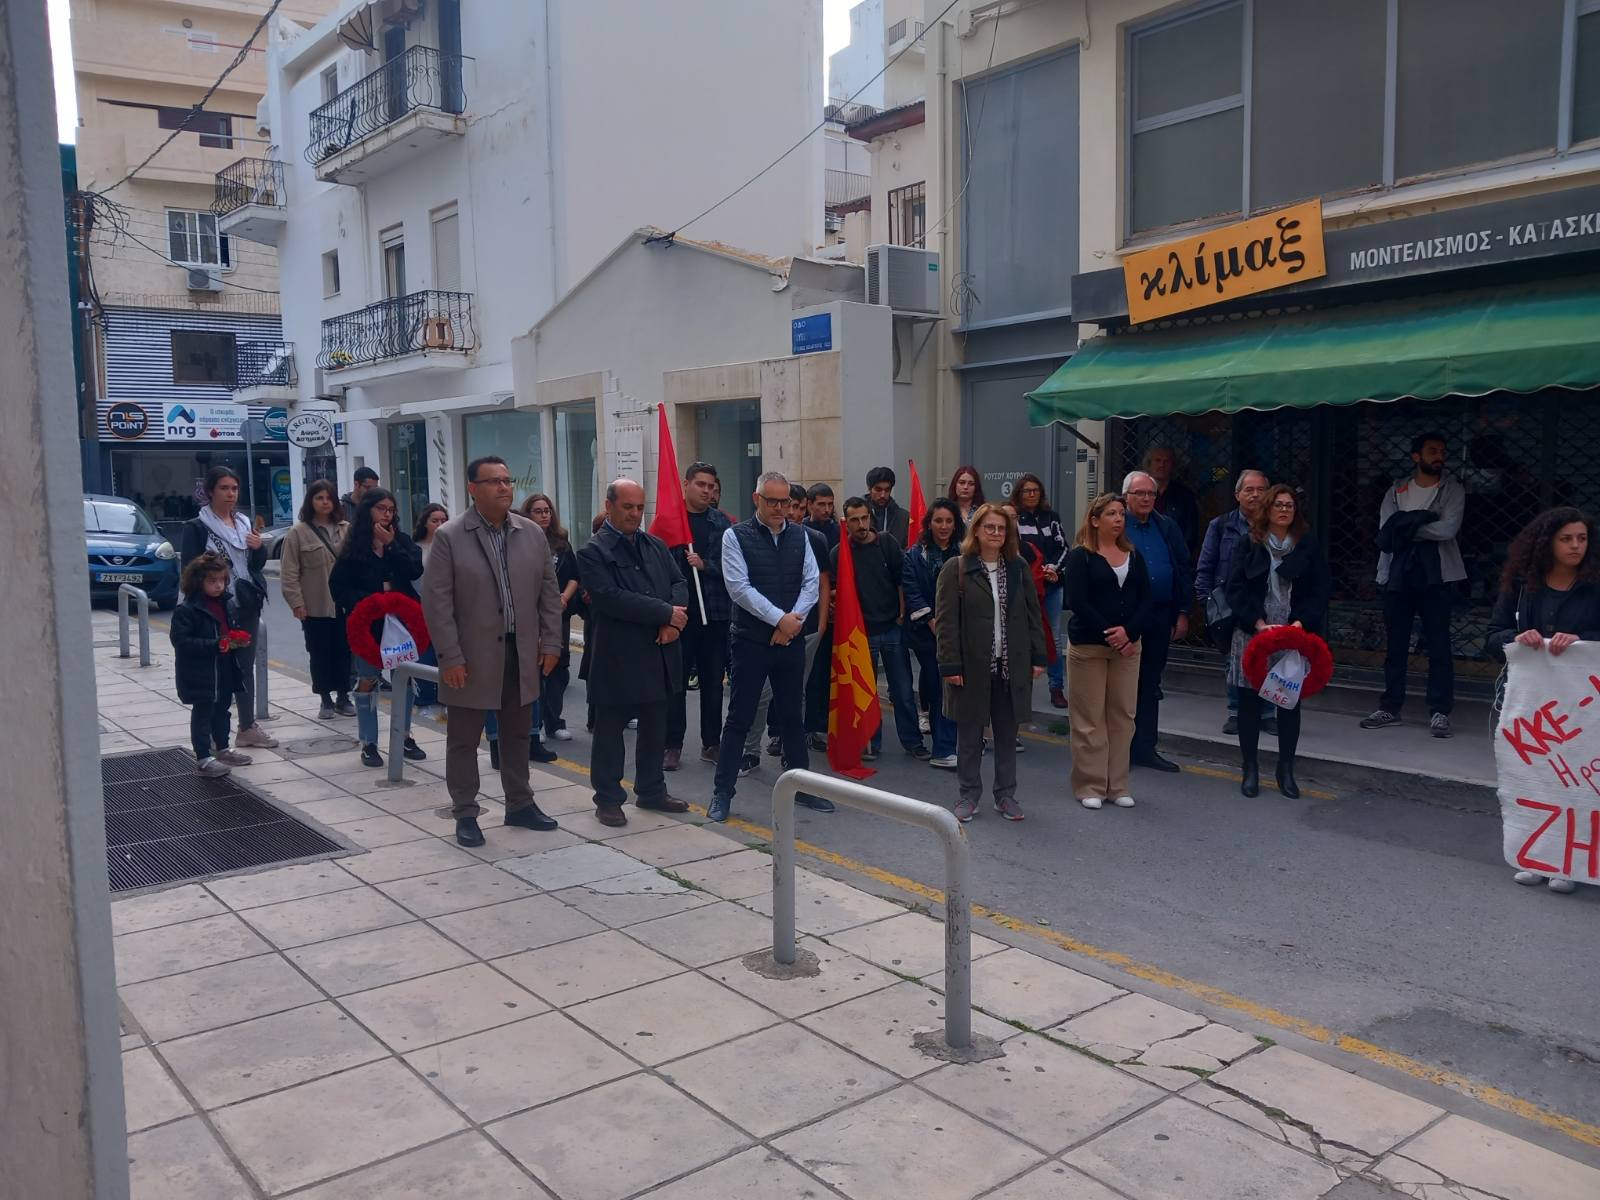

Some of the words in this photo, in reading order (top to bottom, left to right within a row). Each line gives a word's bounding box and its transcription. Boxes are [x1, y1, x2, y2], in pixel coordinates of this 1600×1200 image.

[1140, 216, 1305, 300] κλίμαξ
[1350, 230, 1492, 270] ΜΟΝΤΕΛΙΣΜΟΣ
[168, 425, 196, 438] nrg
[1004, 483, 1011, 496] 3
[1502, 700, 1583, 765] ΚΚΕ
